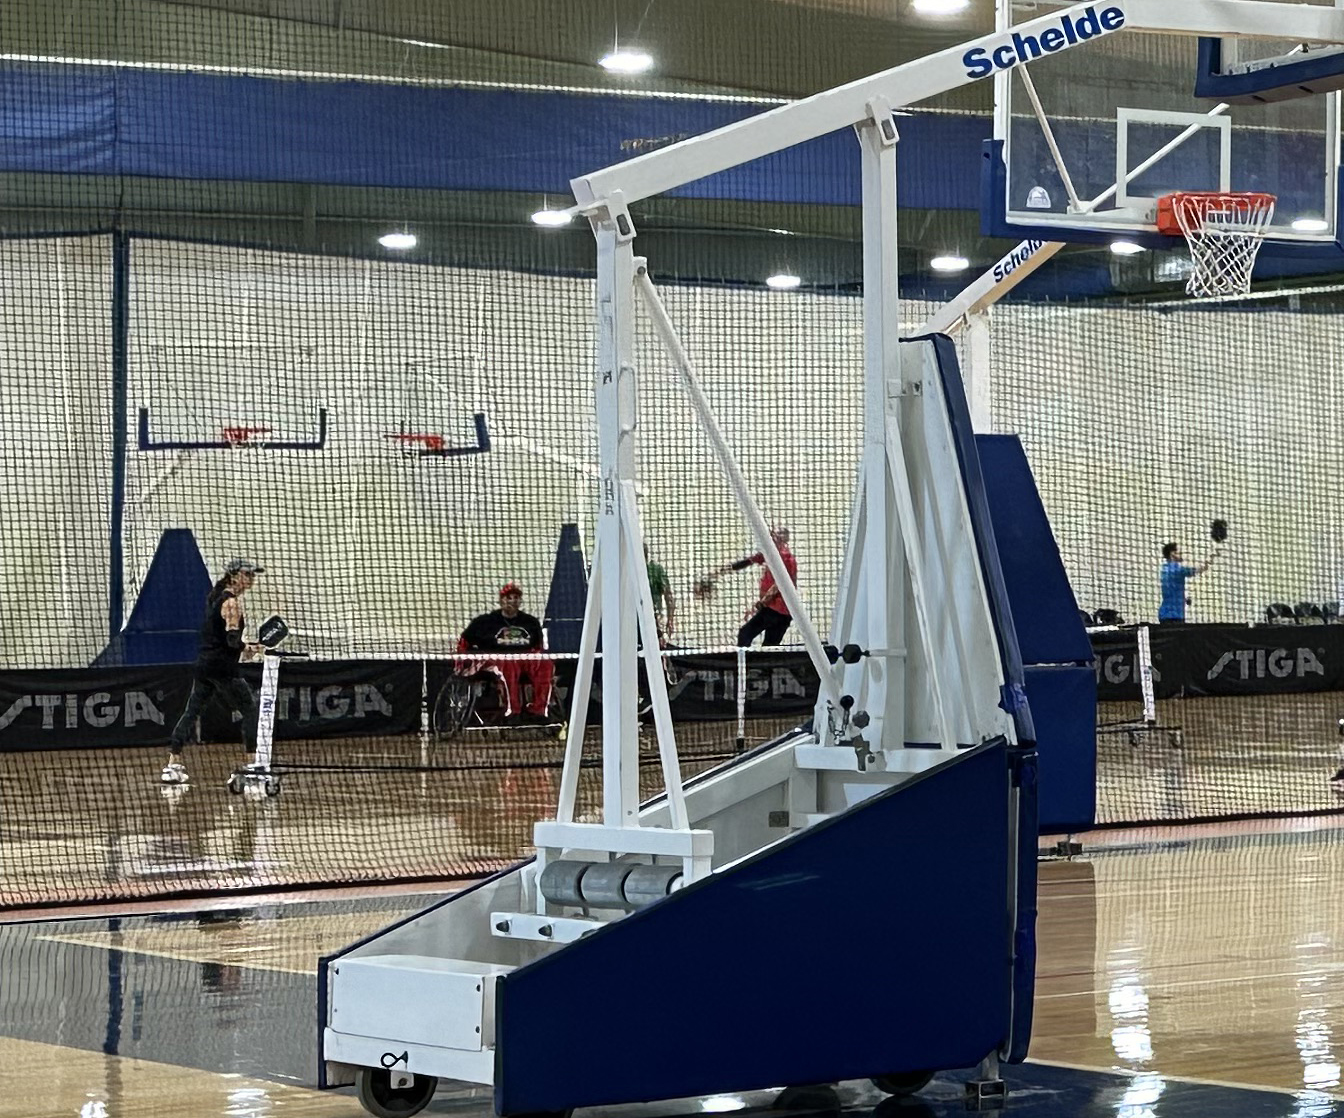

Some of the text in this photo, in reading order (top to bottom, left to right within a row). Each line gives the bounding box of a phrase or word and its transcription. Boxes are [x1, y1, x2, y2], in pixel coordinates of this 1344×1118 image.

[962, 6, 1125, 79] Schelde
[993, 240, 1043, 283] Schel
[1207, 646, 1325, 681] STIGA
[0, 691, 165, 730] STIGA
[232, 684, 392, 722] TIGA
